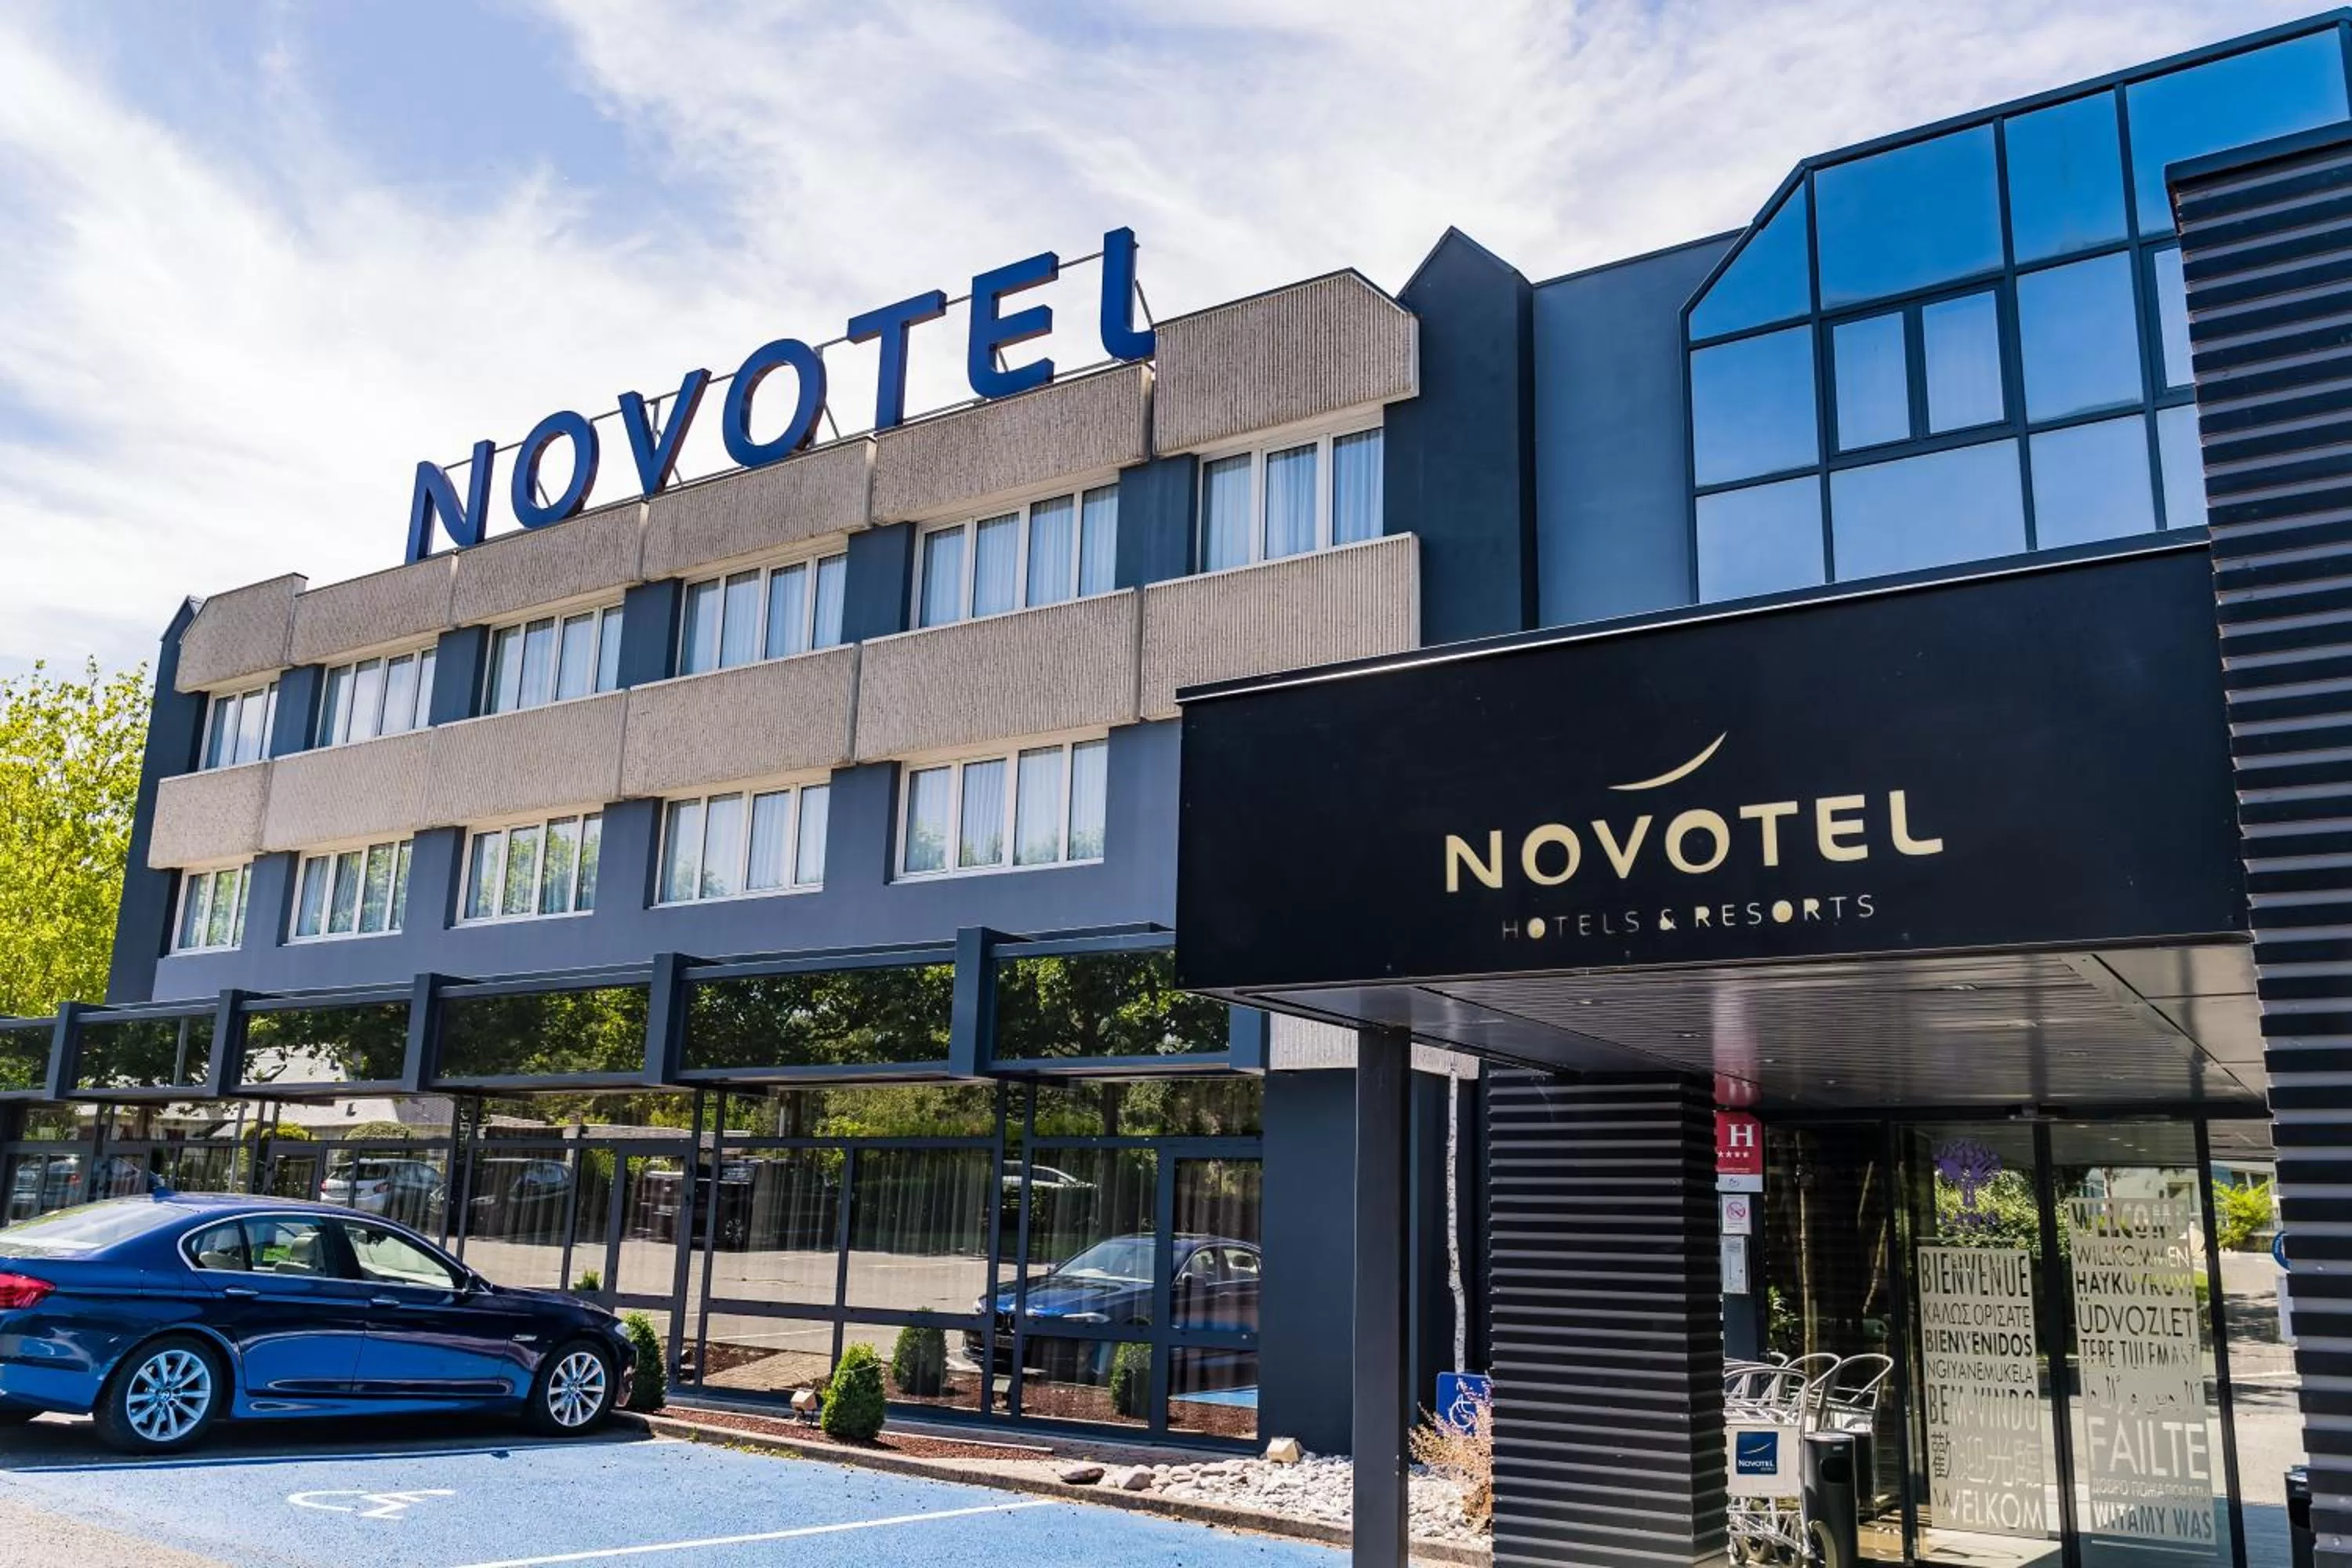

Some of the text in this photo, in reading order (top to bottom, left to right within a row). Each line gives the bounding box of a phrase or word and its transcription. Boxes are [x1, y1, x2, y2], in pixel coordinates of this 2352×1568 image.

[405, 226, 1156, 565] NOVOTEL
[1445, 789, 1944, 893] NOVOTEL
[1502, 894, 1875, 940] HOTELS & RESORTS
[1727, 1123, 1755, 1147] H
[1921, 1252, 2029, 1297] BIENVENUE
[2074, 1245, 2190, 1268] WILLKOMMEN
[1925, 1329, 2032, 1356] BIENVENIDOS
[1926, 1359, 2034, 1383] NGIYANEMUKELA
[1738, 1459, 1774, 1468] NOVOTEL
[1934, 1486, 2045, 1530] WELKOM
[2092, 1500, 2212, 1540] WITAMY WAS
